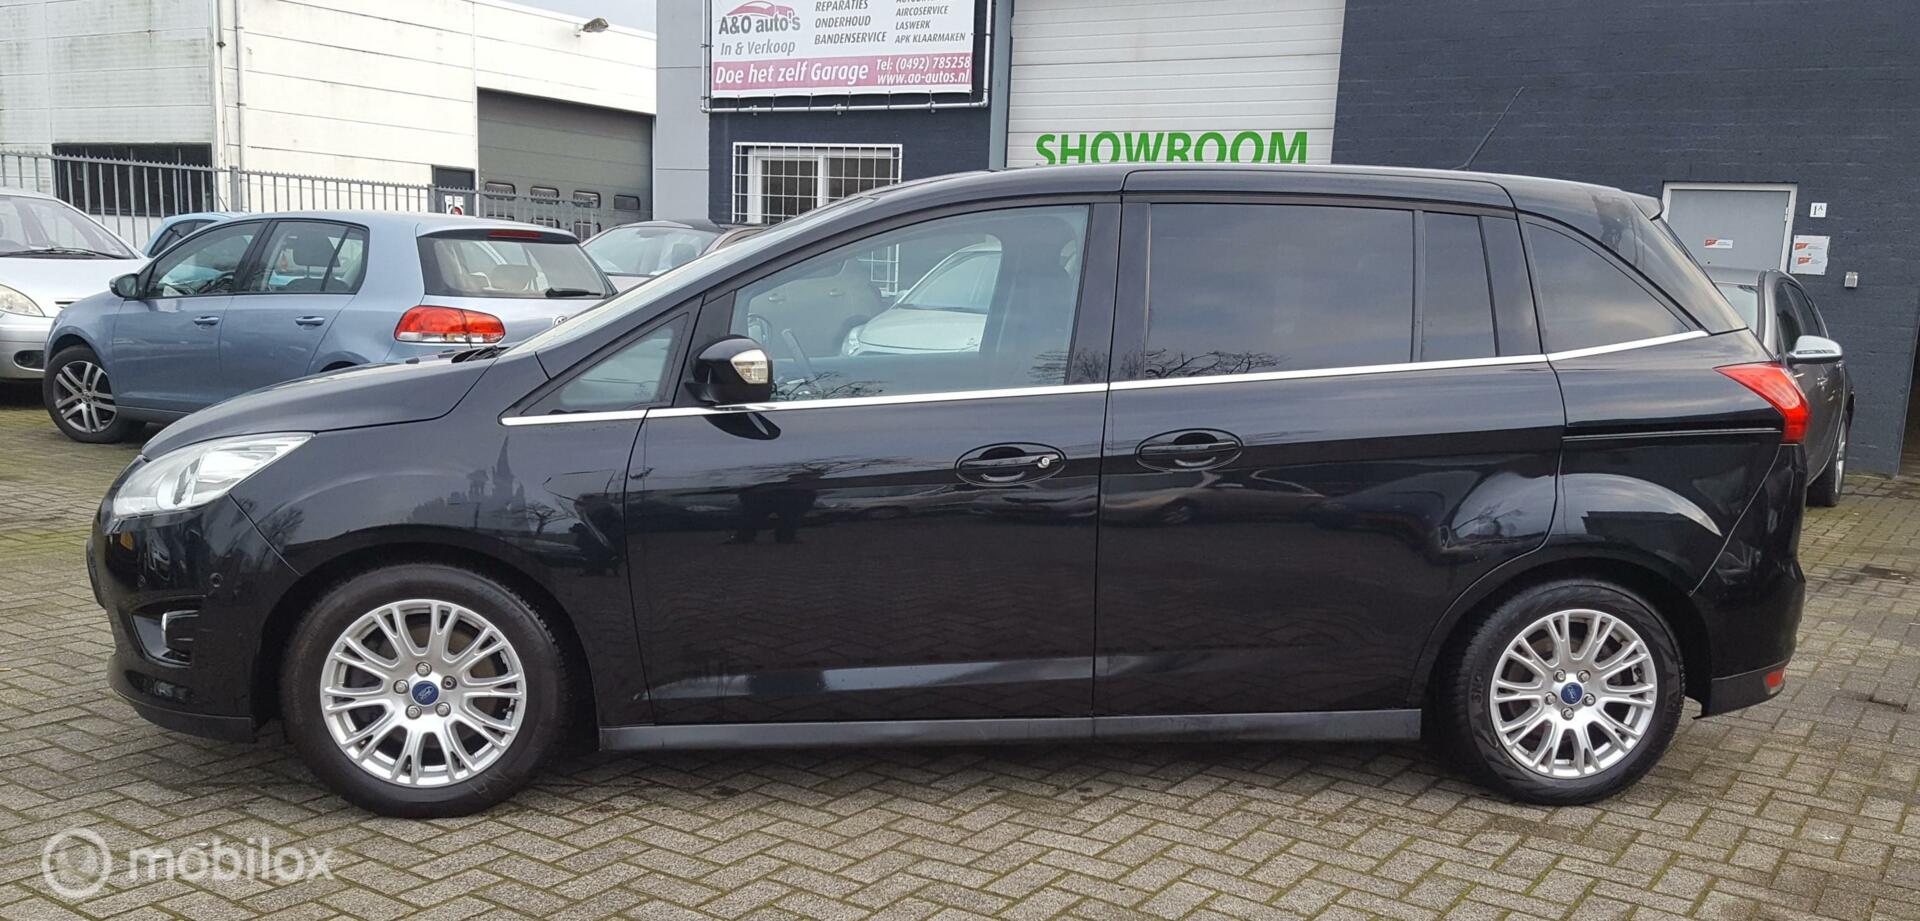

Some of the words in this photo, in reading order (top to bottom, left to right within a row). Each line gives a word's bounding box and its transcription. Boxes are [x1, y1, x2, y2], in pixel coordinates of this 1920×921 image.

[815, 0, 868, 12] REPARATIES
[896, 5, 949, 16] AIRCOSERVICE
[718, 15, 752, 35] A&O
[755, 12, 801, 33] auto's
[815, 15, 871, 28] ONDERHOUD
[895, 20, 930, 30] LASWERK
[814, 31, 887, 45] BANDENSERVICE
[895, 34, 911, 44] APK
[912, 32, 966, 43] KLAARMAKEN
[720, 42, 732, 56] In
[735, 41, 744, 55] &
[747, 38, 796, 56] Verkoop
[876, 56, 893, 71] Tel:
[895, 56, 930, 72] (0492)
[932, 56, 971, 70] 785258
[715, 66, 744, 84] Doe
[748, 63, 774, 83] het
[777, 60, 808, 82] zelf
[811, 62, 869, 85] Garage
[876, 69, 970, 85] www.ao-autos.nl
[1036, 130, 1308, 164] SHOWROOM
